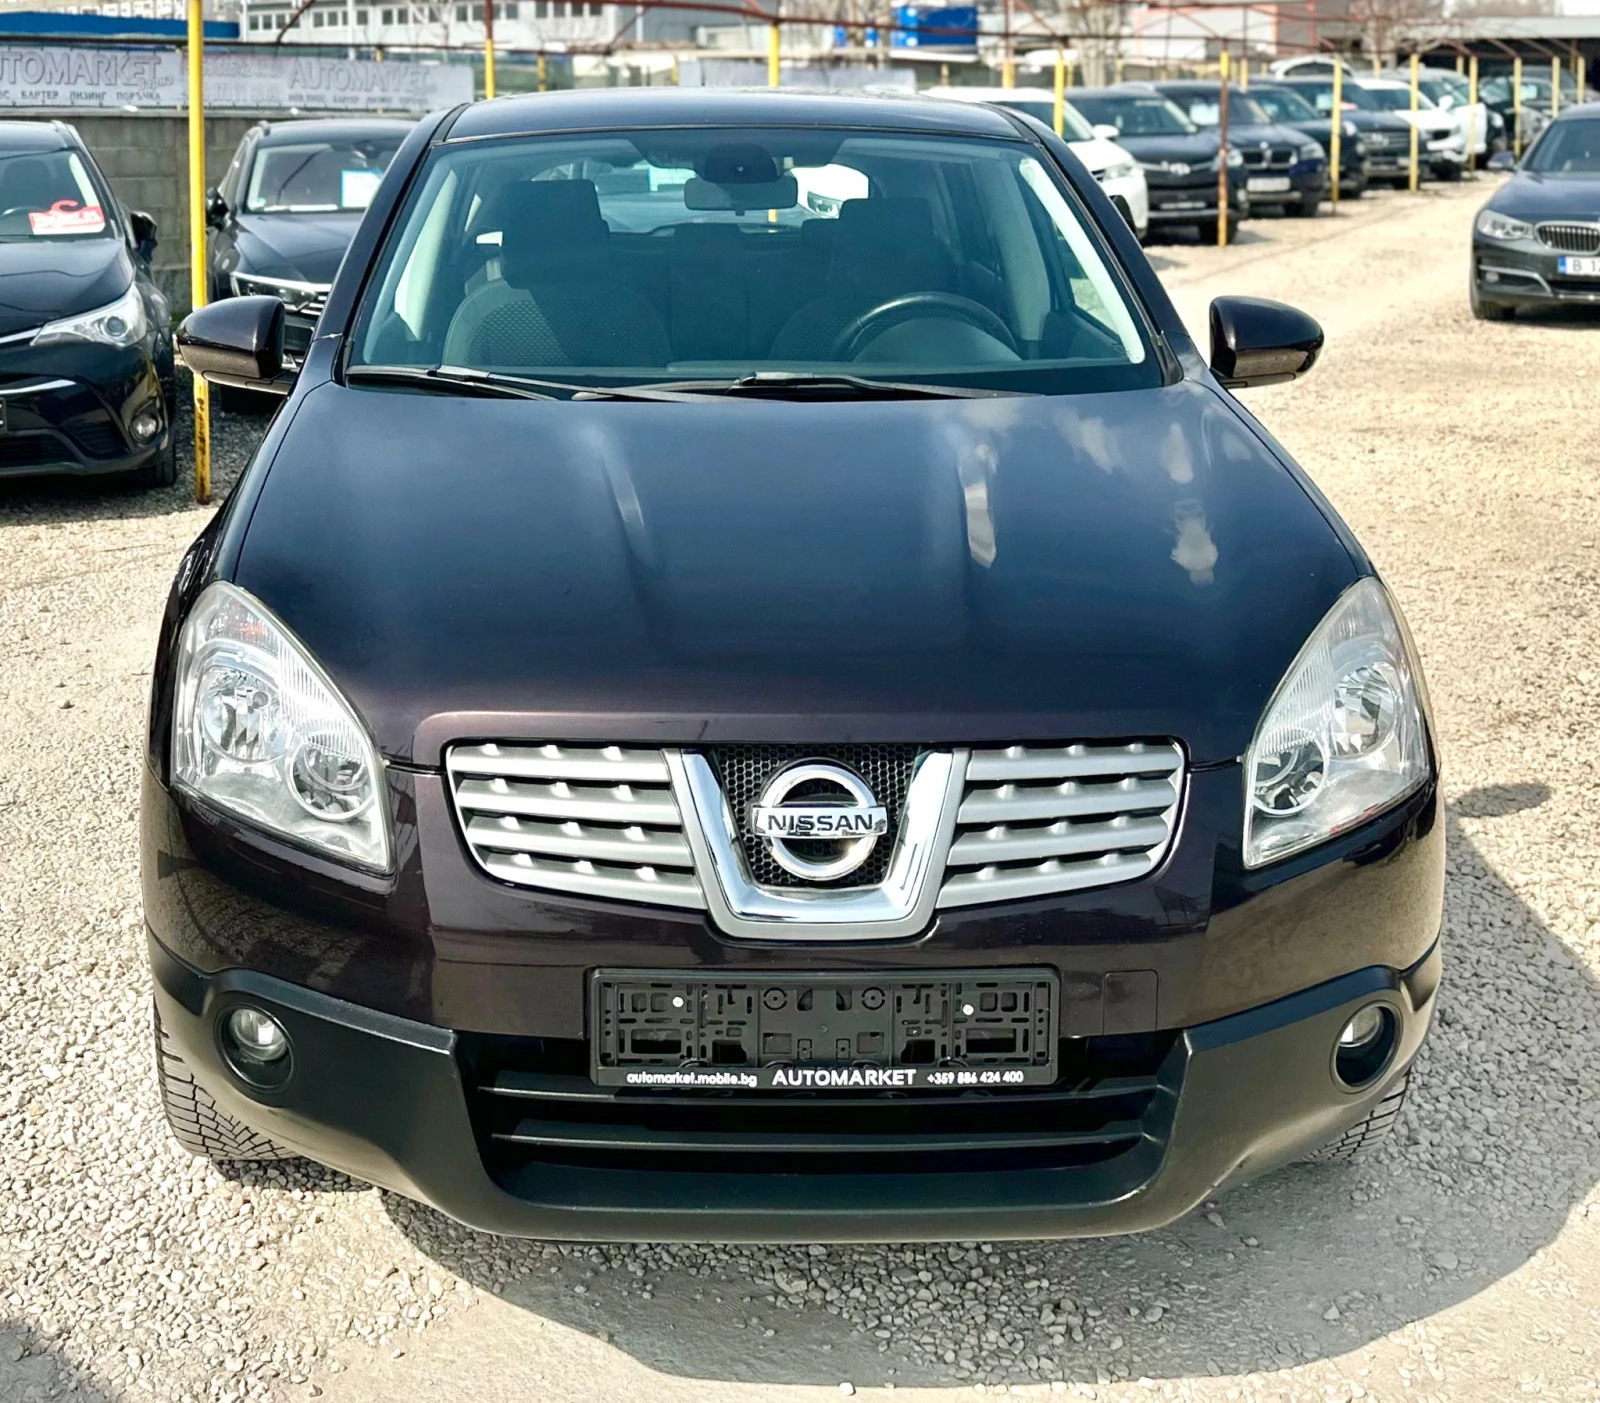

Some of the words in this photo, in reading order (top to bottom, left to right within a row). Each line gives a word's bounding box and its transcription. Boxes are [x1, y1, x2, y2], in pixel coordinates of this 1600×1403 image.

[768, 814, 873, 831] NISSAN
[626, 1070, 758, 1087] automarket.mobile.bg
[772, 1069, 917, 1087] AUTOMARKET
[927, 1071, 952, 1085] +359
[979, 1071, 1001, 1084] 424
[1002, 1071, 1024, 1083] 400
